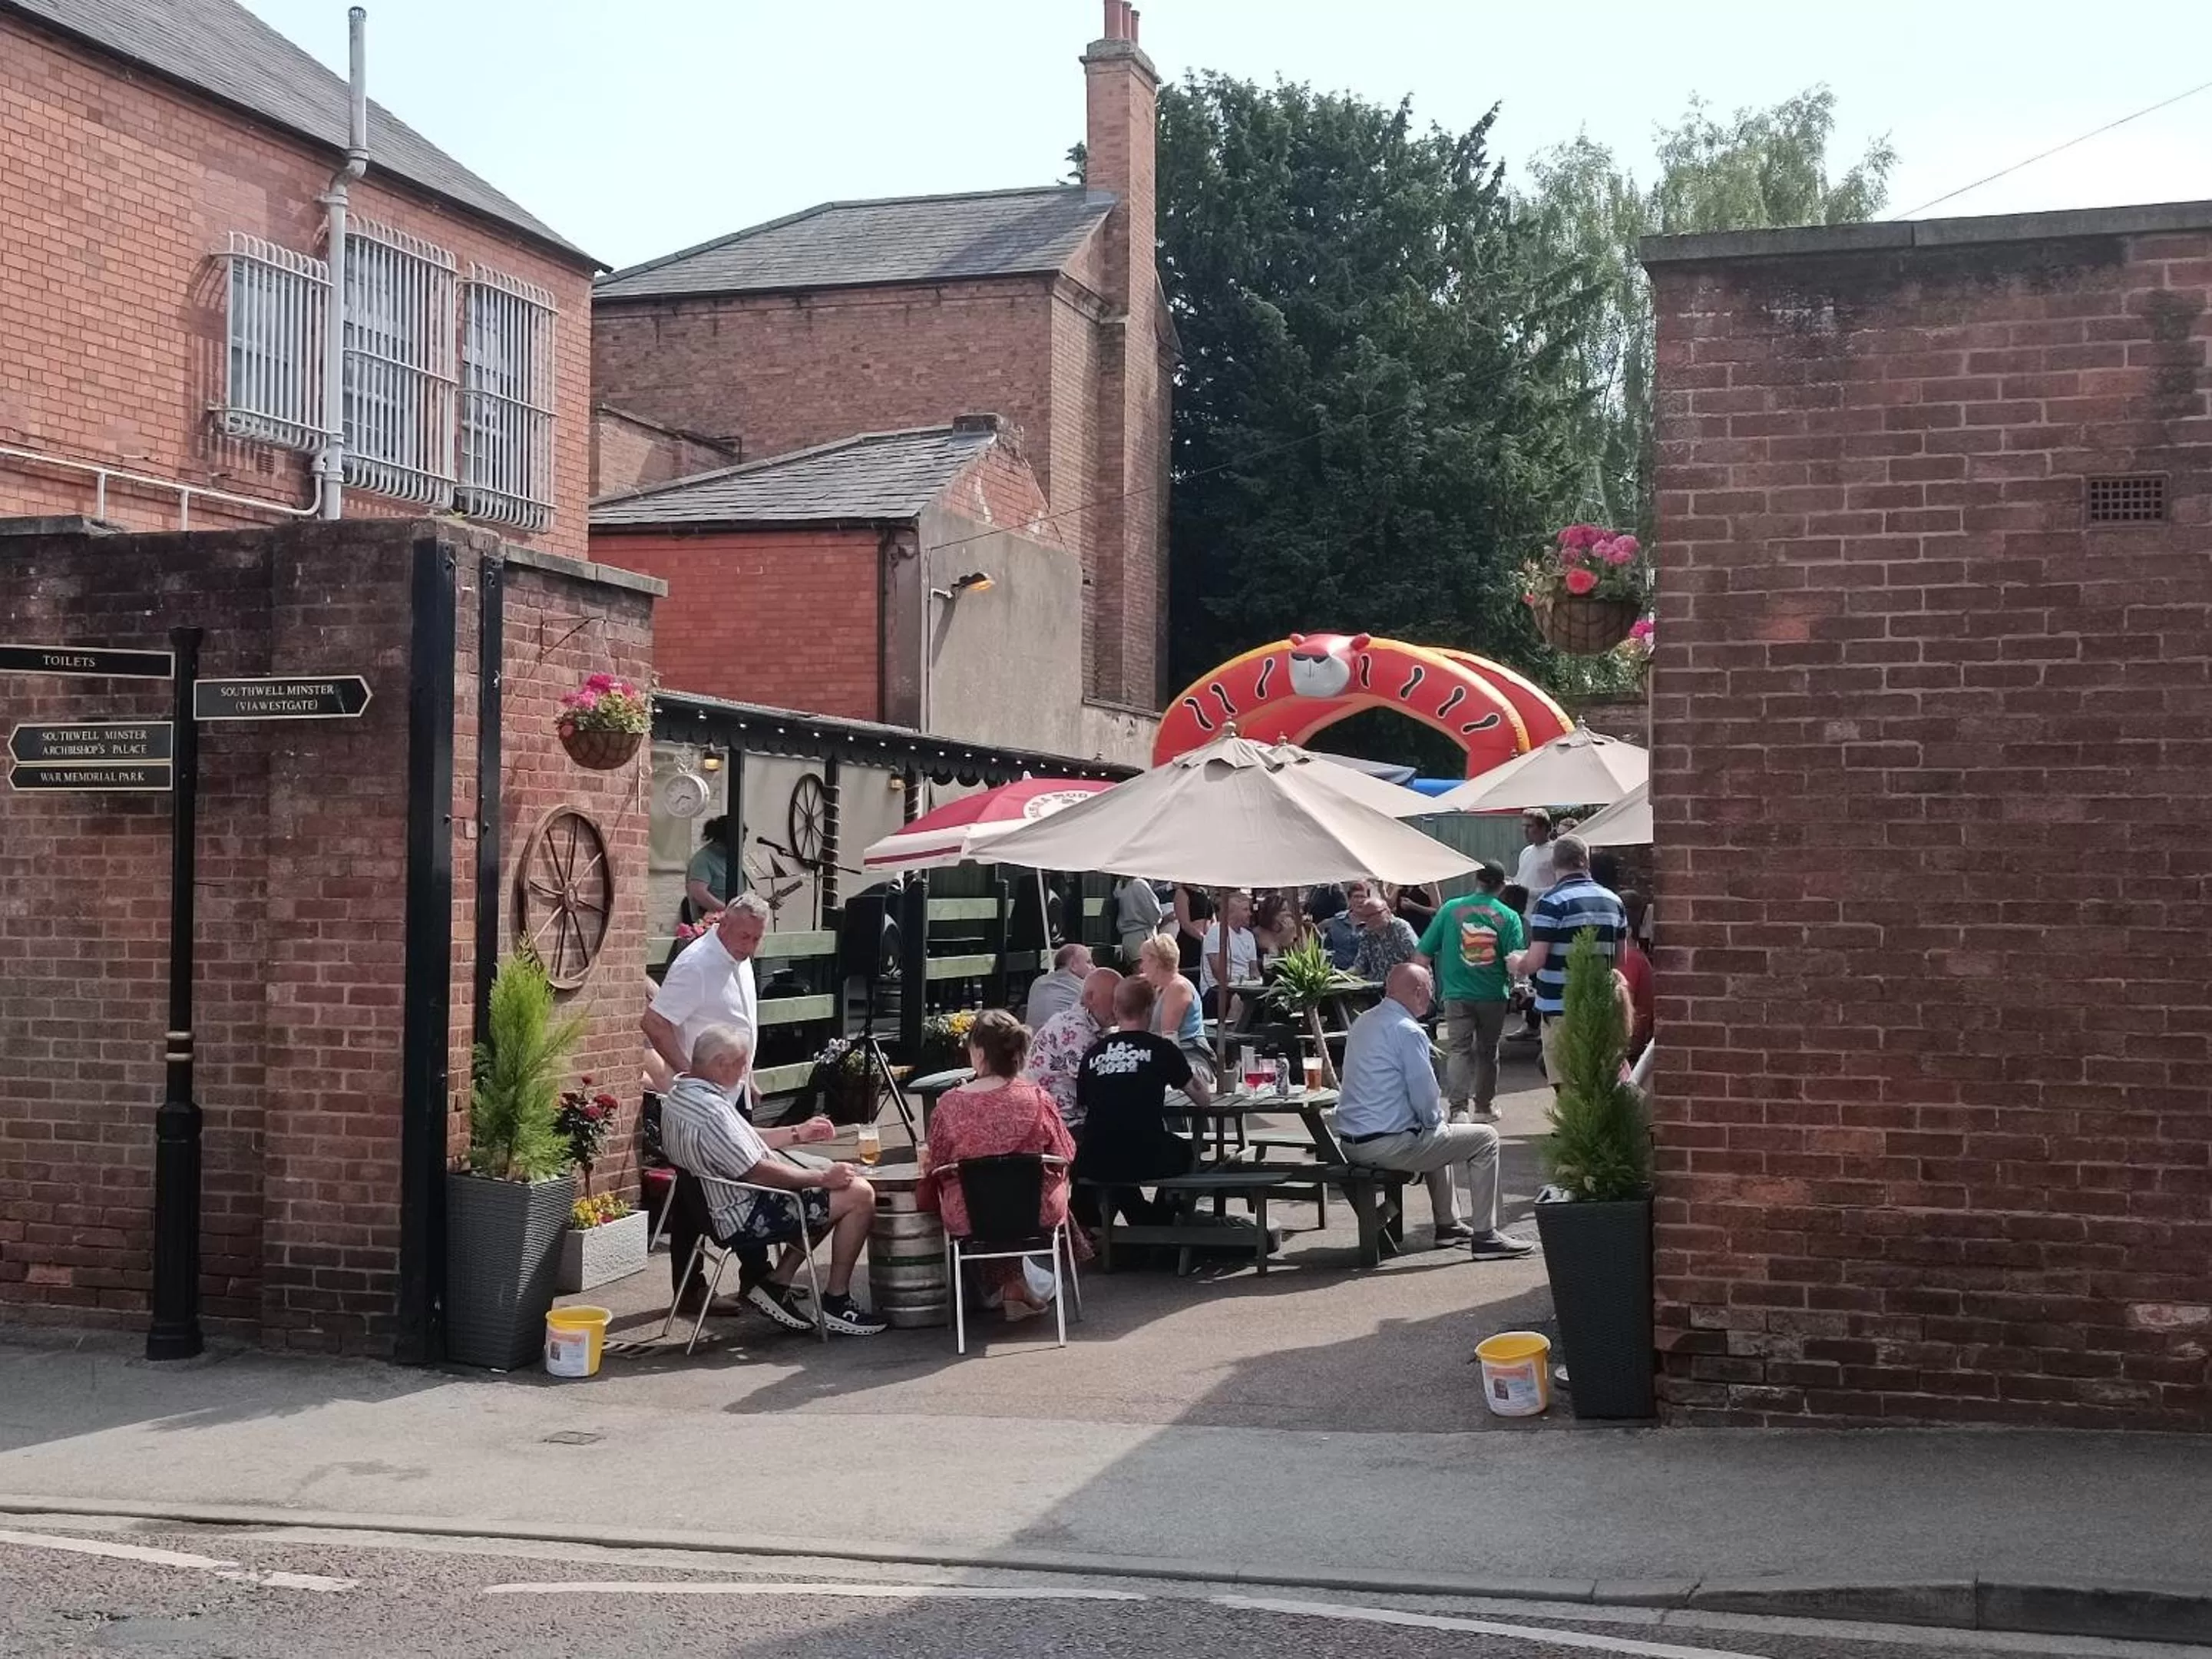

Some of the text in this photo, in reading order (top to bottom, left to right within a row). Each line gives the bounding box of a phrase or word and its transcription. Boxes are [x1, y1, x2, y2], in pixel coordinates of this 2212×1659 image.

[42, 654, 96, 667] TOILETS
[220, 684, 334, 697] SOUTHWELL MINSTER
[235, 699, 319, 712] (VIA WESTGATE)
[41, 729, 147, 741] SOUTHWELL MINSTER
[41, 743, 147, 755] ARCHBISHOP'S PALACE
[40, 771, 145, 782] WAR MEMORIAL PARK
